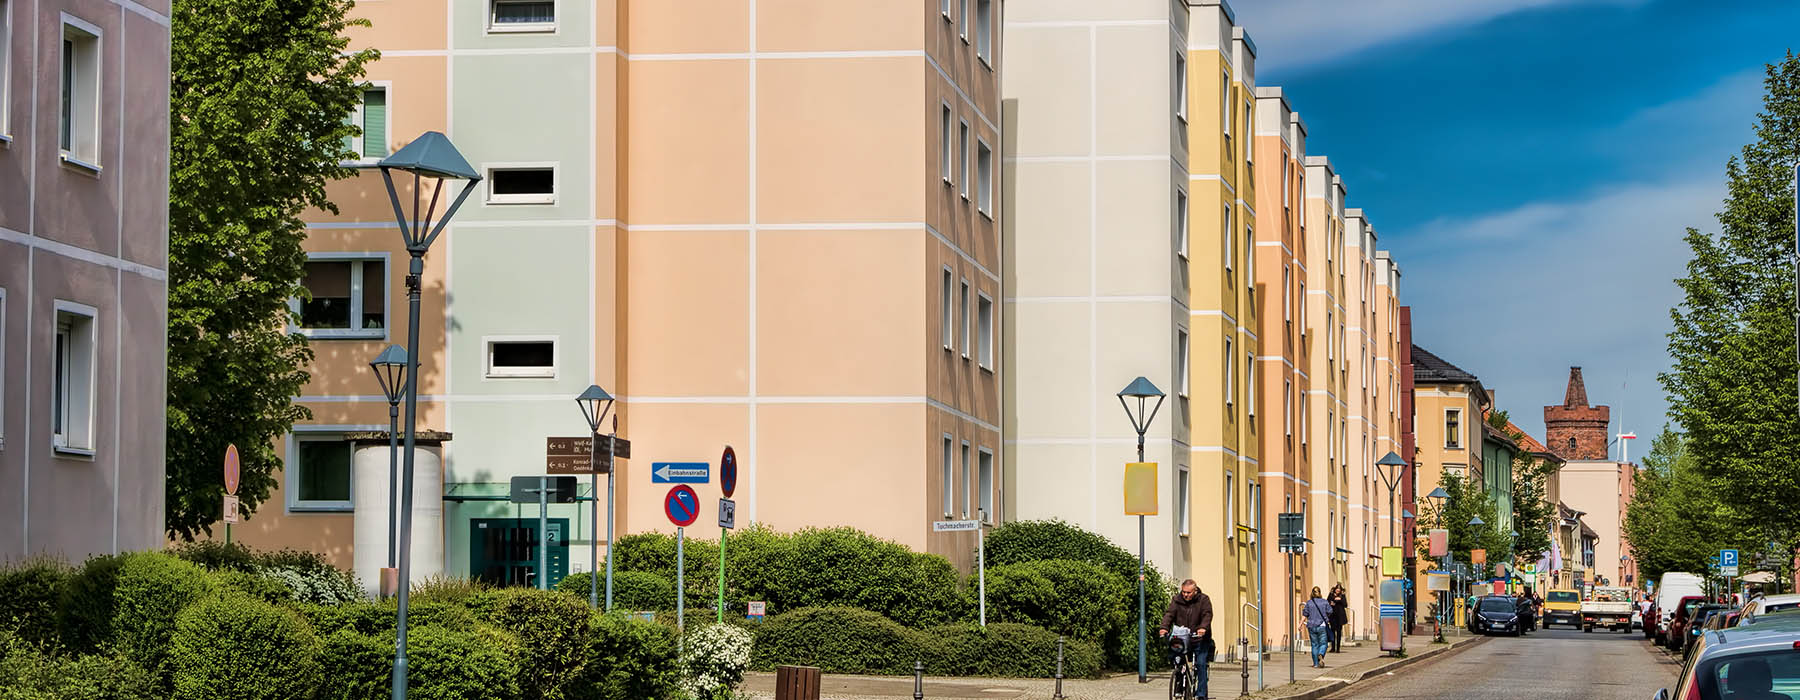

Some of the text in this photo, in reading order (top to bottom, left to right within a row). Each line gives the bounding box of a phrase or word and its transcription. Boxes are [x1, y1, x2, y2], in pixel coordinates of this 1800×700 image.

[936, 522, 976, 530] Tuchmacherstr.
[548, 532, 555, 541] 2
[1724, 552, 1734, 564] P
